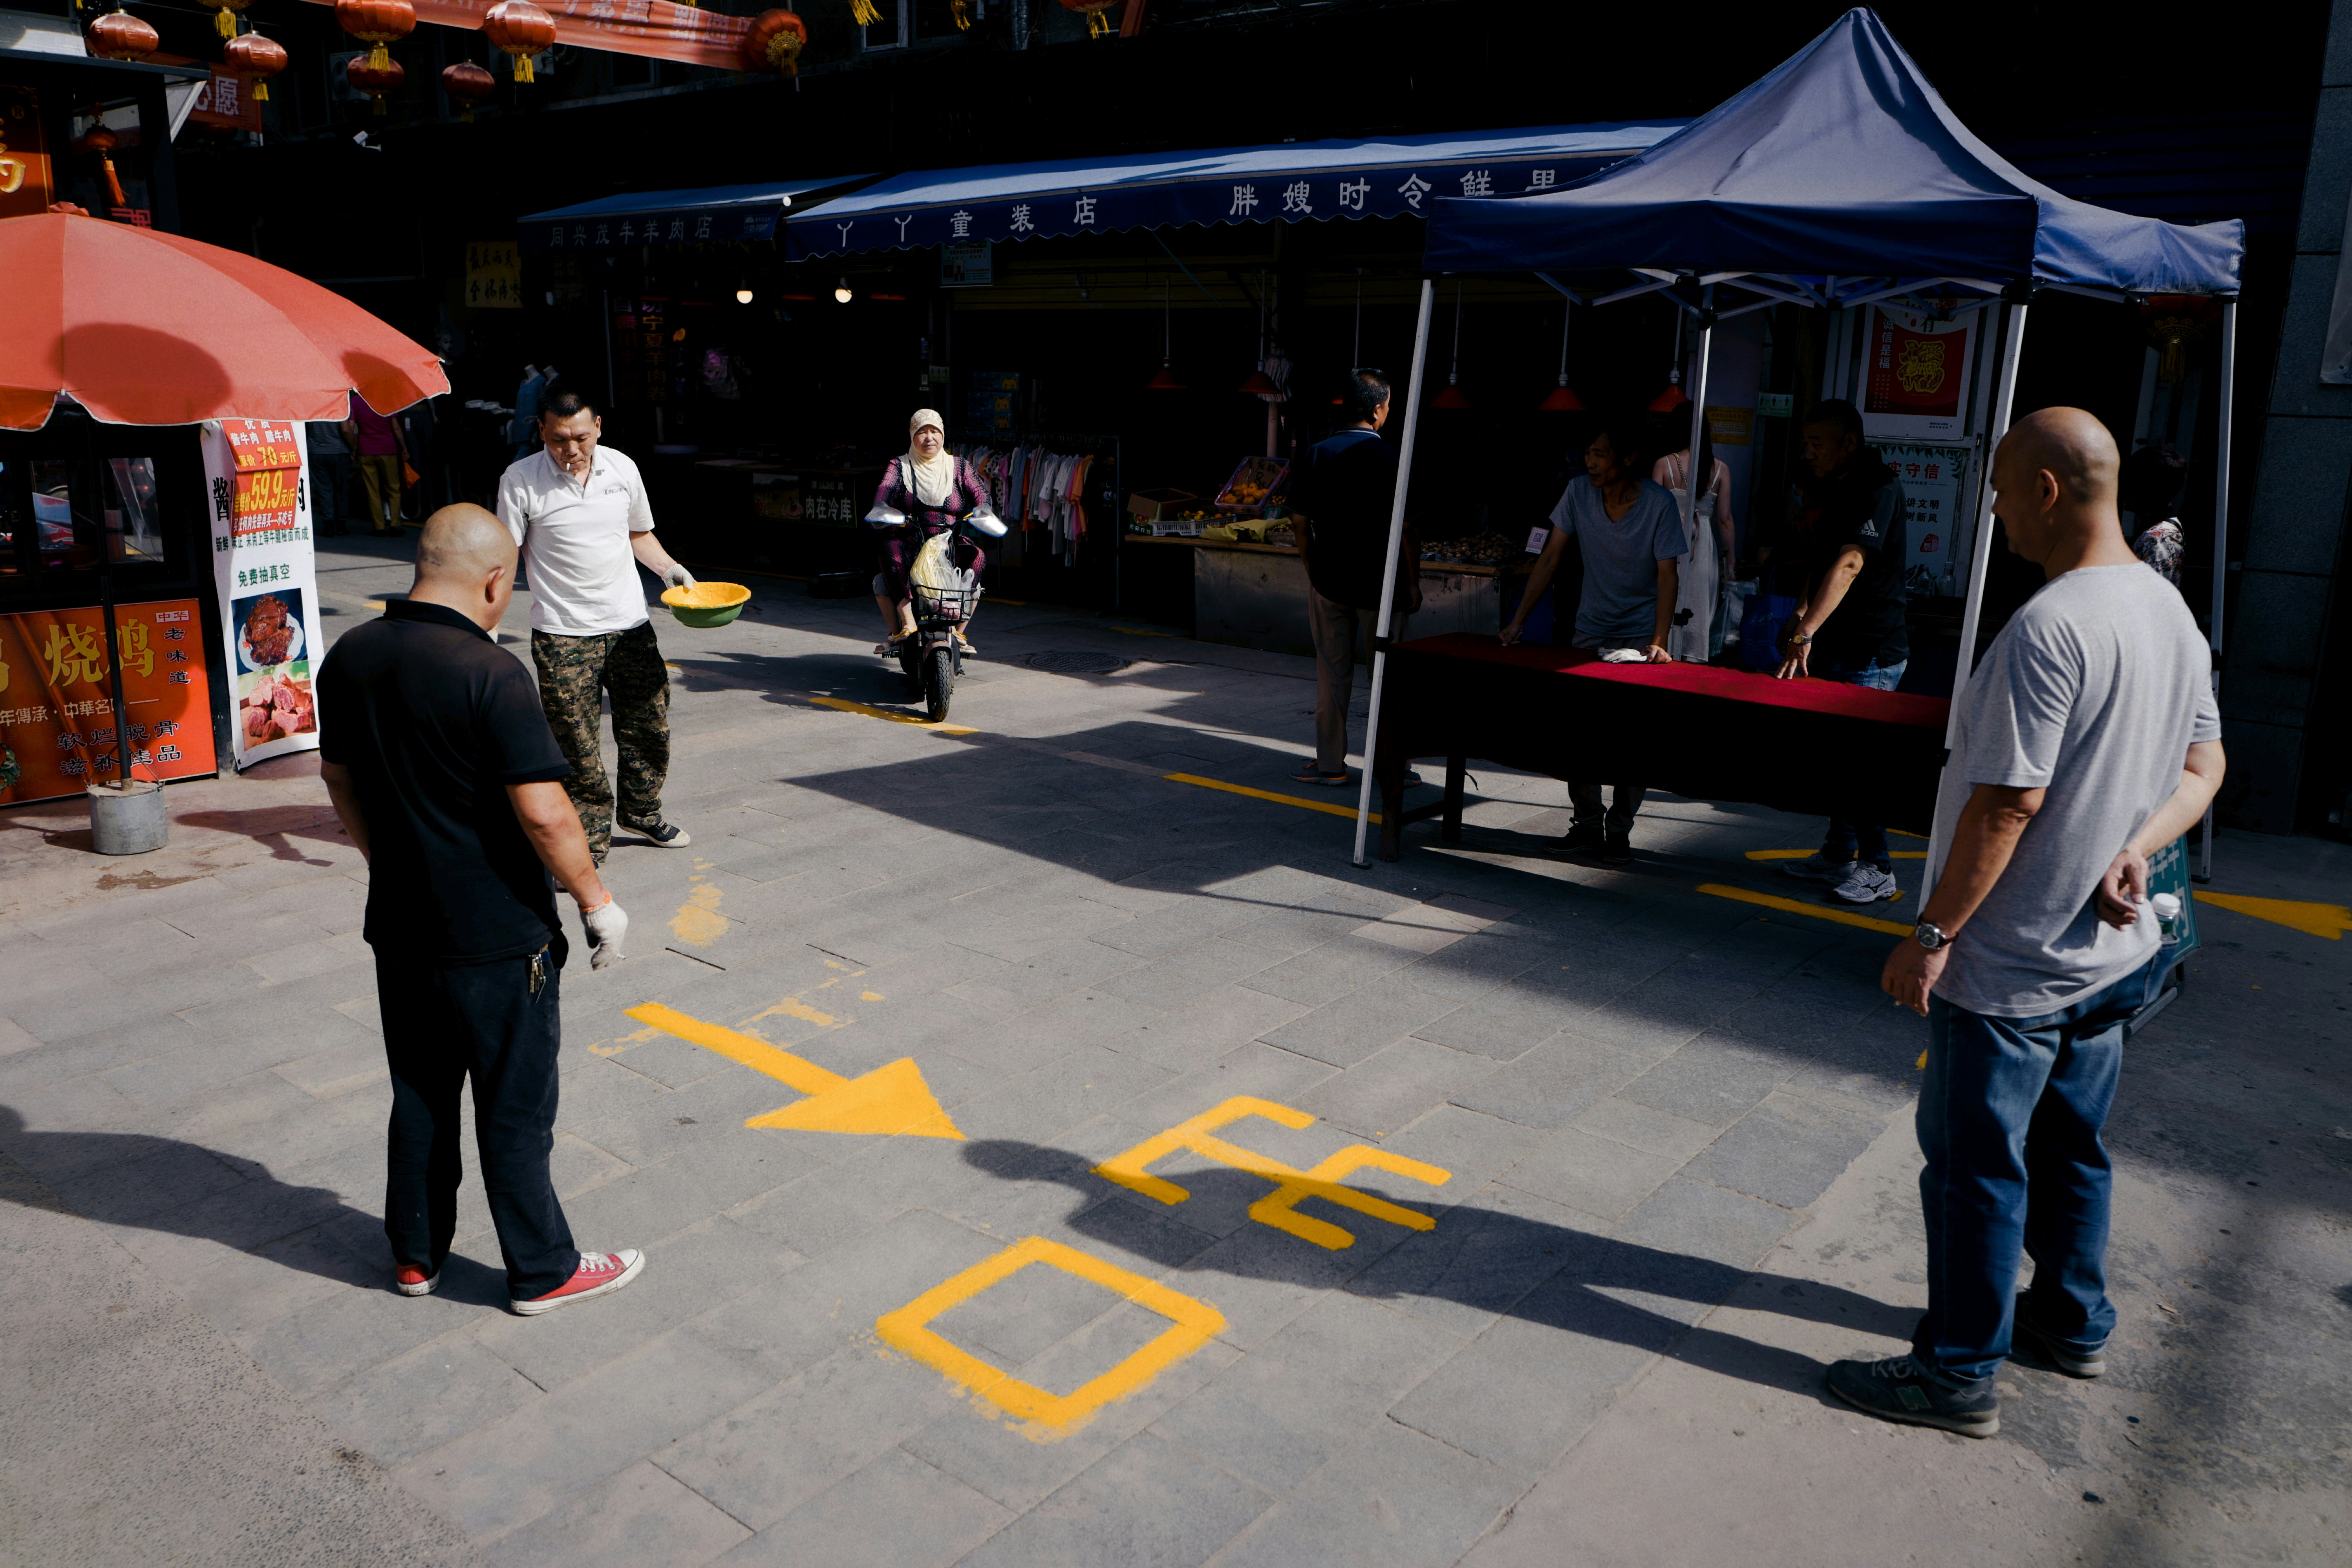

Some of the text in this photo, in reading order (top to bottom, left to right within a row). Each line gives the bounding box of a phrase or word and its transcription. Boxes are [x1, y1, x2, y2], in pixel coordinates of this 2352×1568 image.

[550, 214, 712, 247] 同兴茂牛羊肉店
[836, 196, 1097, 247] 丫丫童装店
[1879, 318, 1895, 369] 诚信是福
[230, 429, 292, 446] 酱牛肉 腊牛肉
[239, 446, 296, 467] 原价 70 元/斤
[805, 495, 852, 522] 肉在冷库
[1906, 498, 1939, 510] 讲文明
[1906, 512, 1938, 523] 树新风
[1854, 529, 1878, 537] adidas
[238, 564, 290, 587] 免费抽真空
[159, 611, 188, 622] 中华
[0, 619, 155, 693] 烧鸡
[164, 627, 191, 684] 老味道
[58, 719, 179, 750] 软烂脱骨
[60, 745, 182, 776] 滋补佳品
